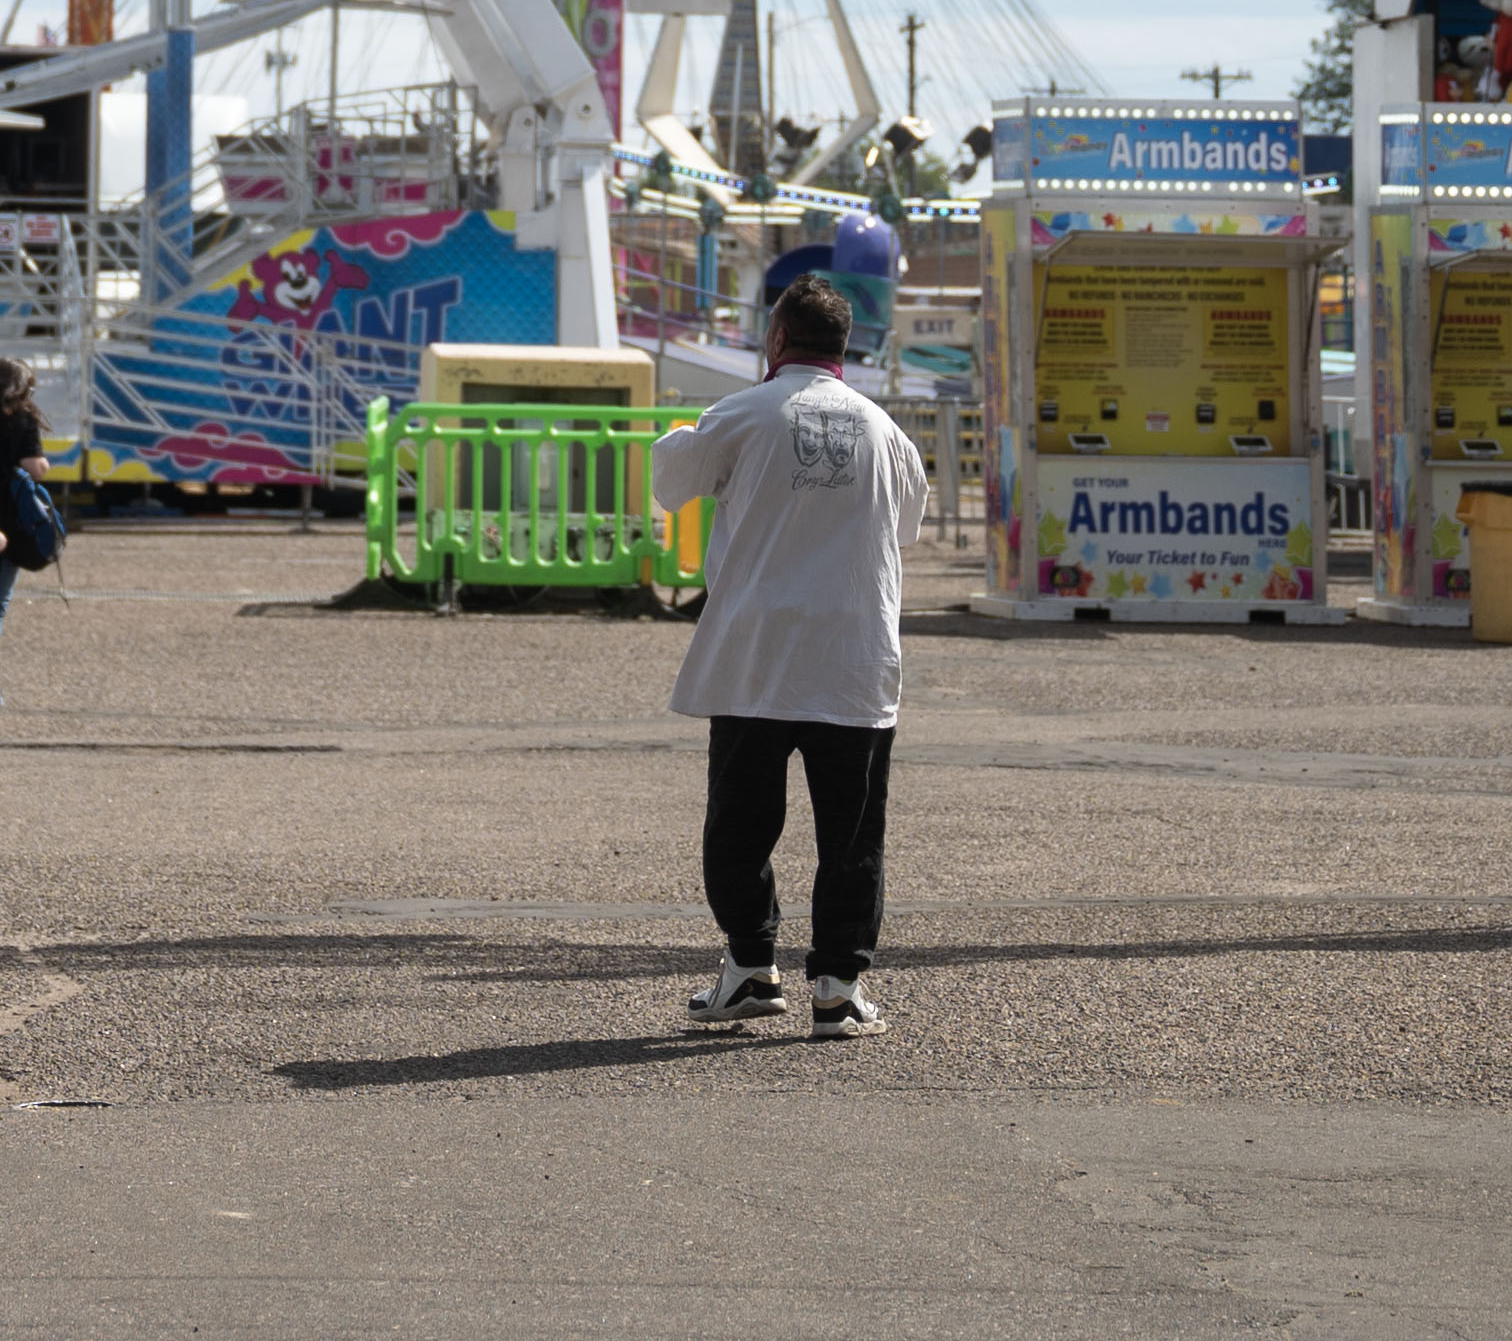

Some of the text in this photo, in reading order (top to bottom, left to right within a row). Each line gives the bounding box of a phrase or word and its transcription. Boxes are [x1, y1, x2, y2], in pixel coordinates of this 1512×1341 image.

[1108, 130, 1289, 171] Armbands
[219, 275, 463, 380] GIANT
[1098, 477, 1129, 488] YOUR
[1068, 490, 1291, 537] Armbands
[1106, 549, 1251, 566] Your Ticket to Fun
